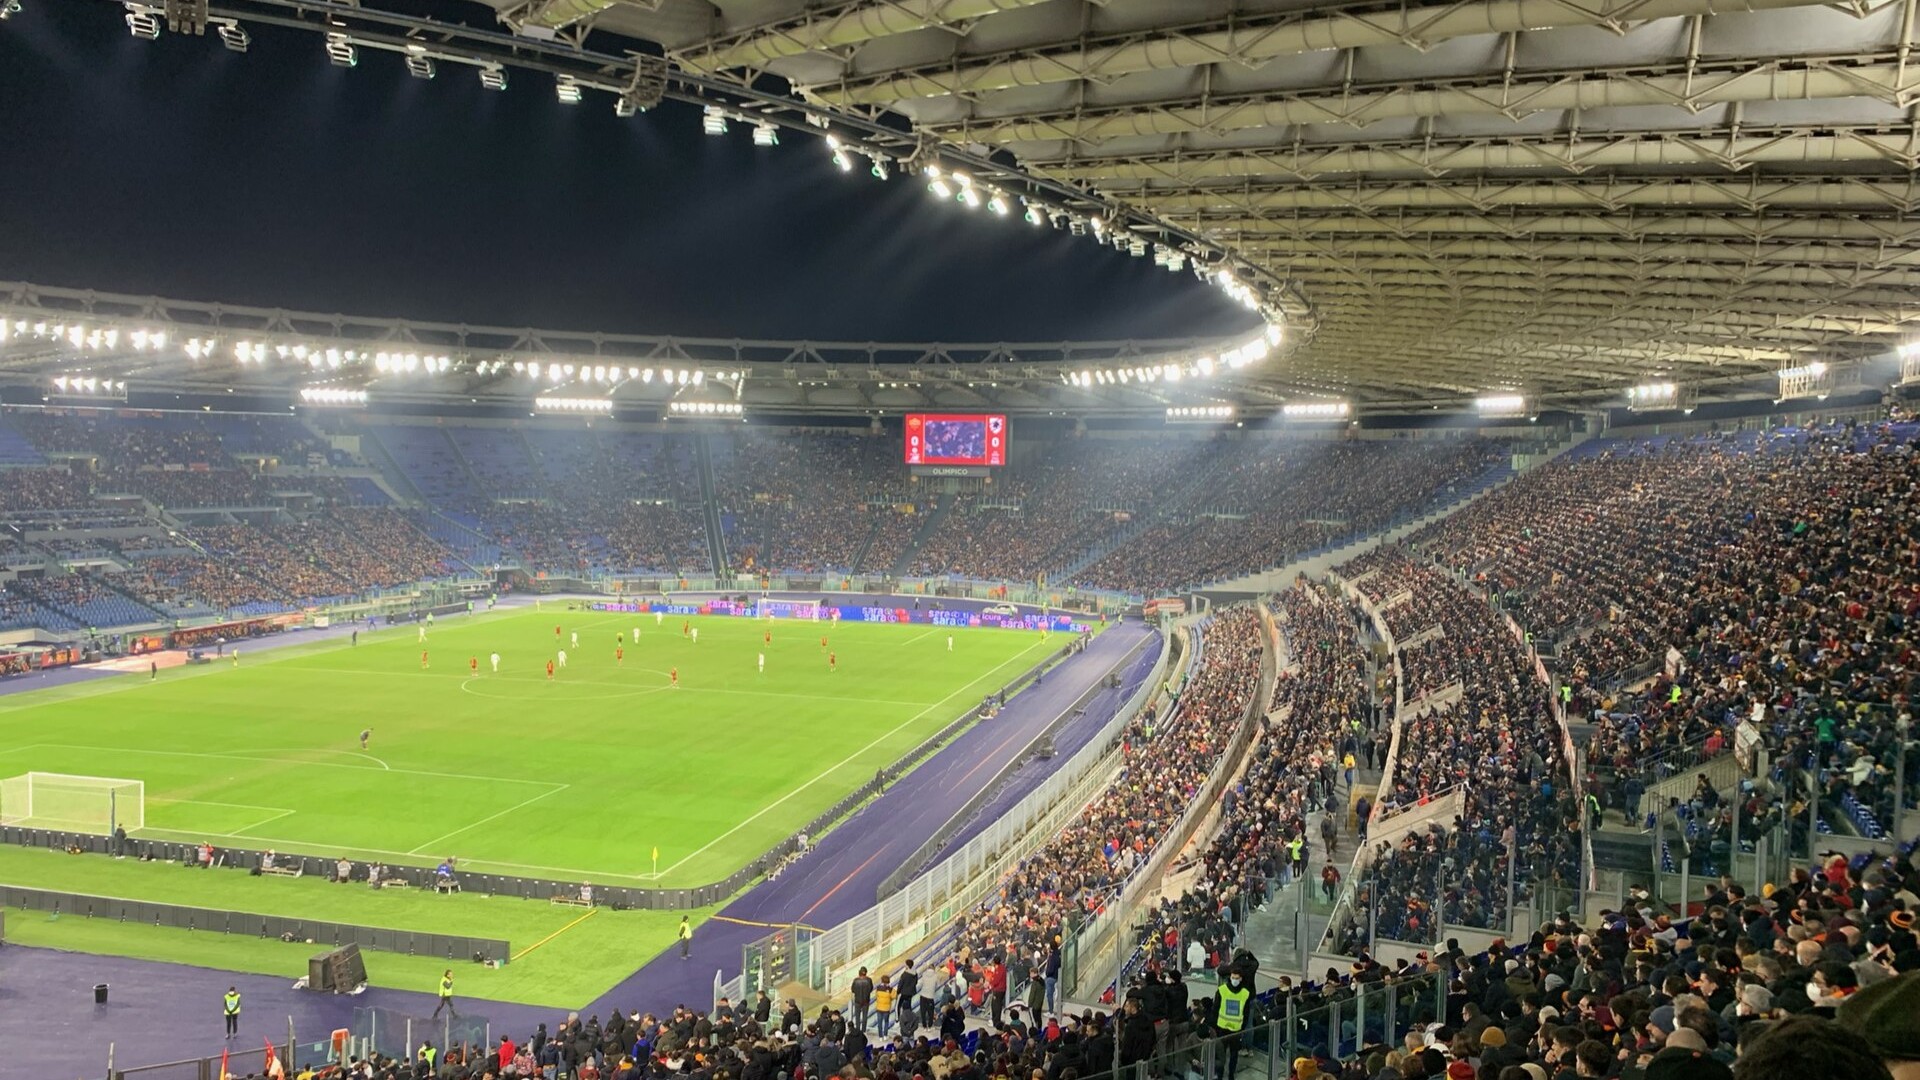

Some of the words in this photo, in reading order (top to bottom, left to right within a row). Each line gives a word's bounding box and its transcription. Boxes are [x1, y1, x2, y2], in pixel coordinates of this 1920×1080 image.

[911, 436, 919, 447] 0
[991, 437, 1000, 448] 0
[606, 603, 628, 612] sara
[667, 605, 689, 614] sara
[729, 606, 752, 616] sara
[864, 613, 888, 622] sara
[932, 616, 956, 626] sara
[1000, 619, 1026, 629] sara
